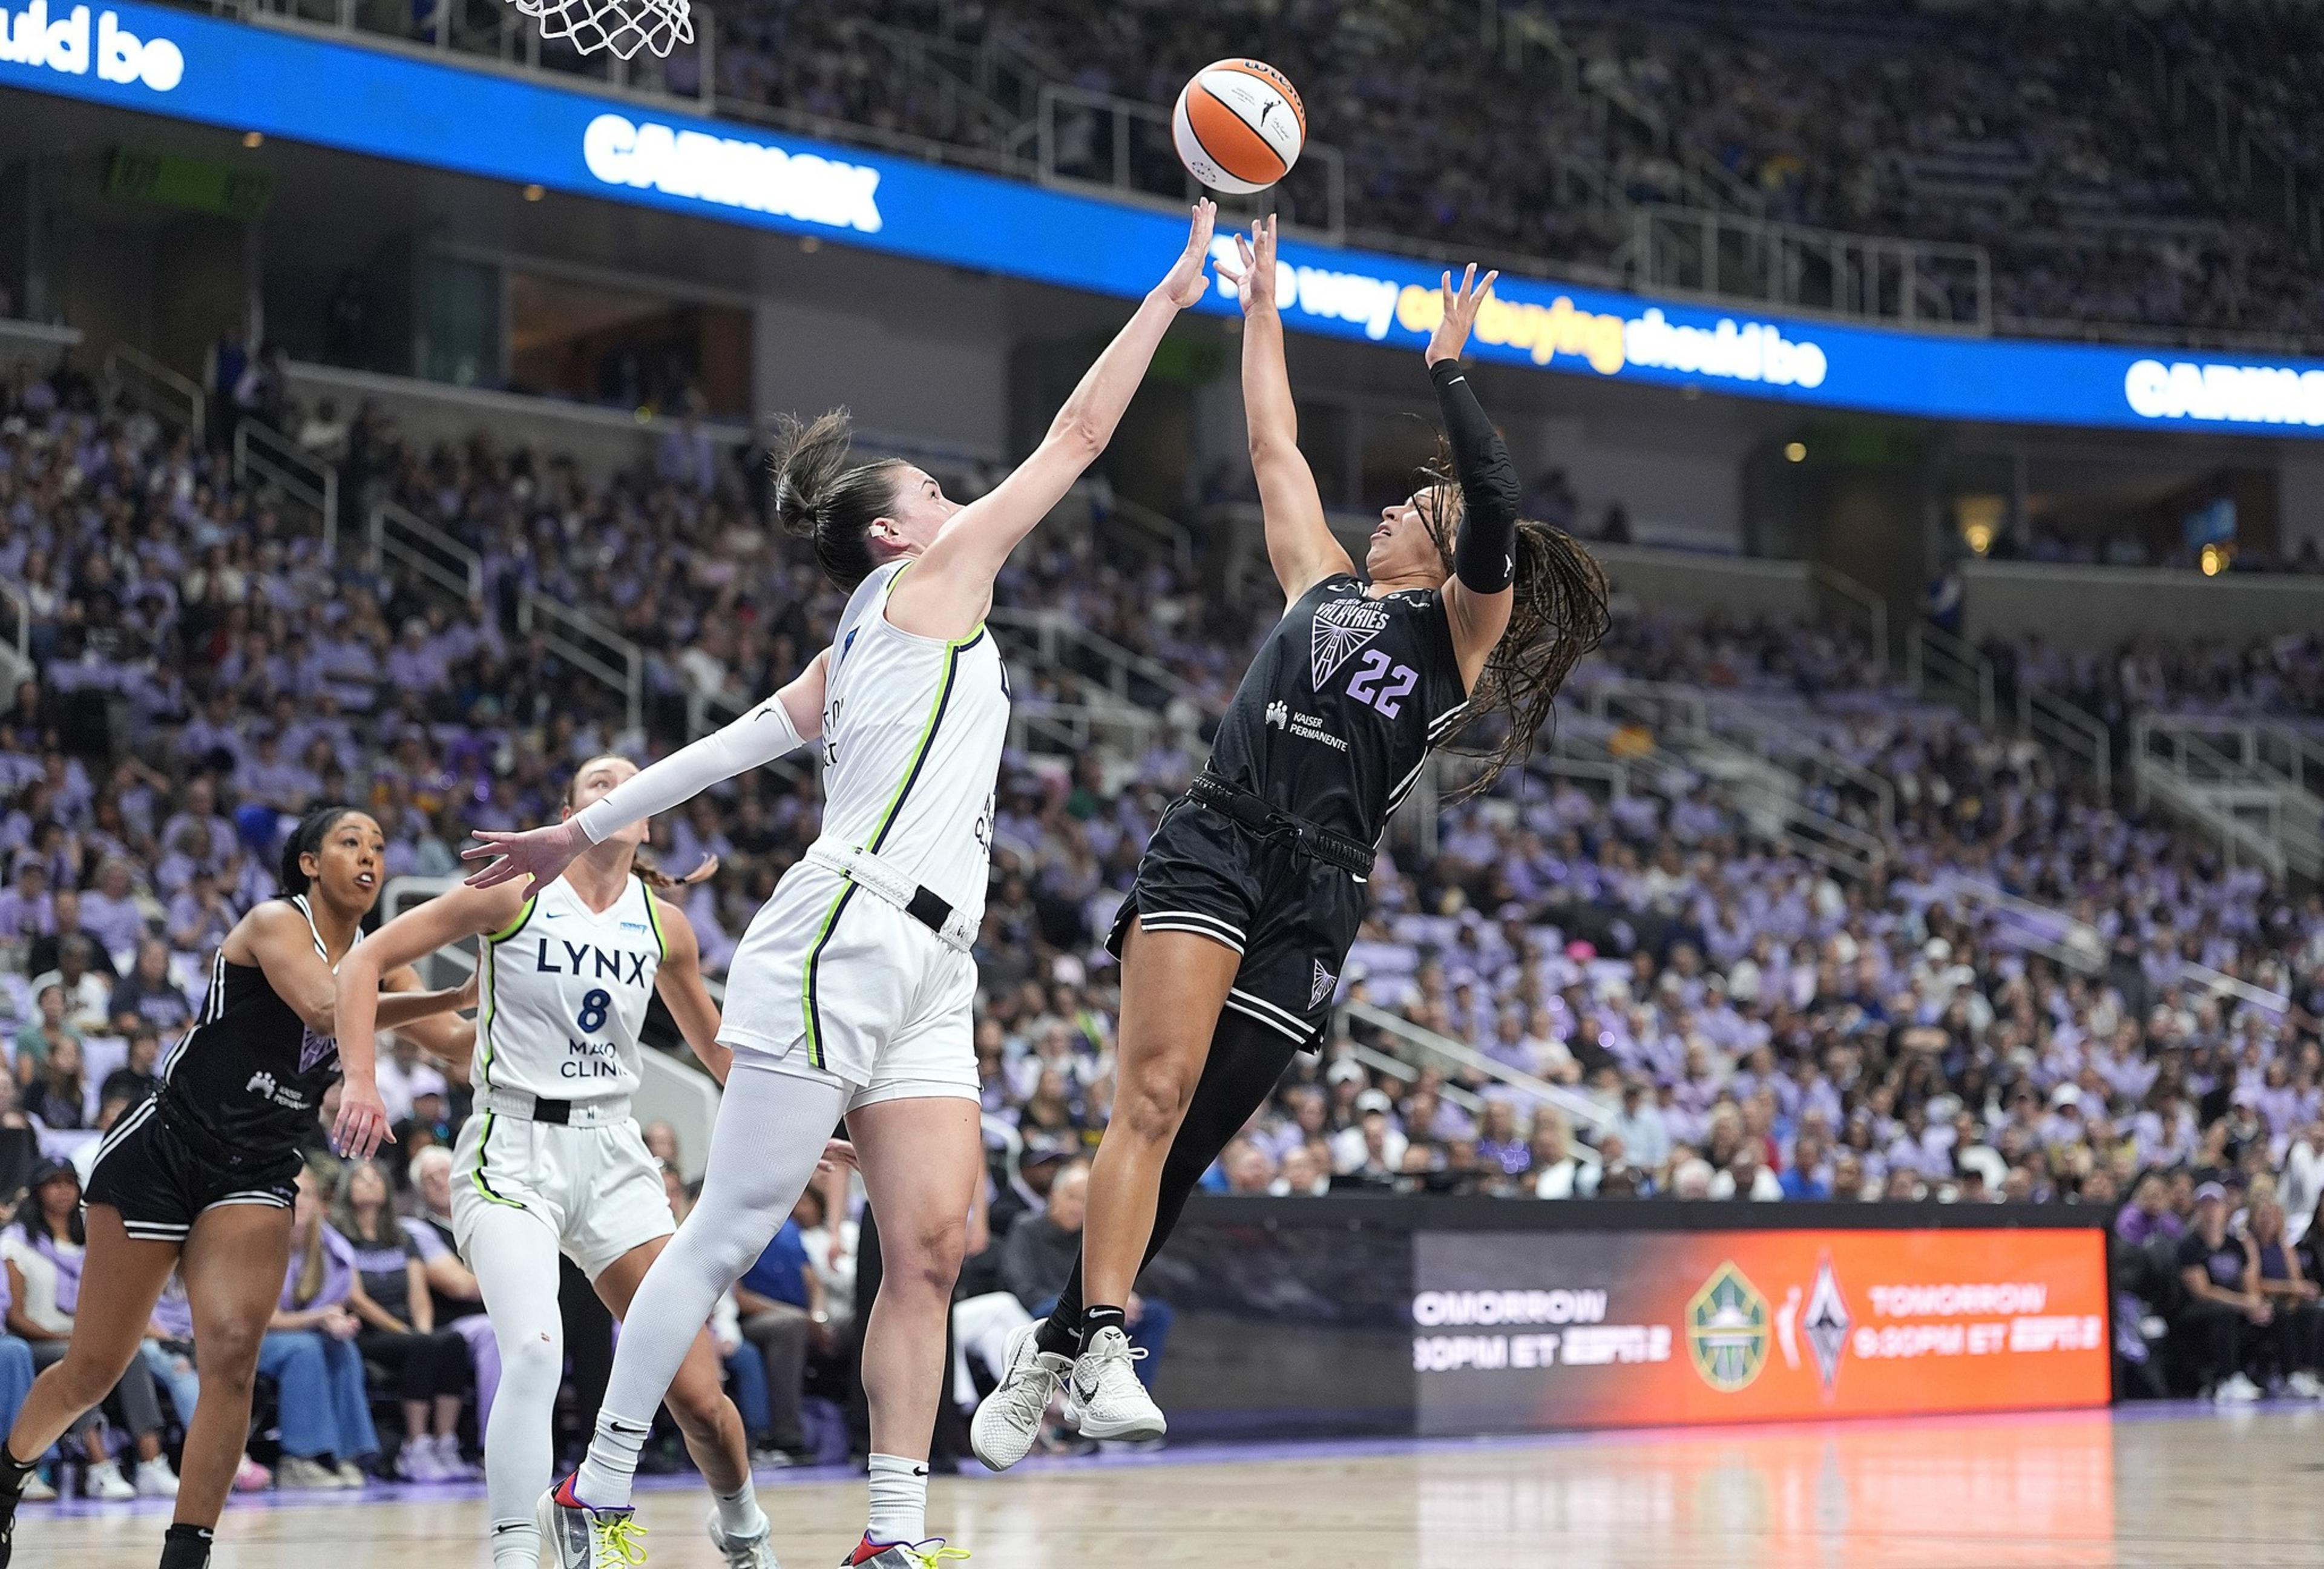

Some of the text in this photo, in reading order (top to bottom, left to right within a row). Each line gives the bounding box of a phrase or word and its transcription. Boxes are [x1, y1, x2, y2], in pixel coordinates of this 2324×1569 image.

[1315, 602, 1390, 630] VALKYRIES
[1345, 648, 1419, 720] 22
[1289, 724, 1348, 752] PERMANENTE
[1293, 711, 1323, 729] KAISER
[537, 938, 647, 988] LYNX
[577, 988, 611, 1033] 8
